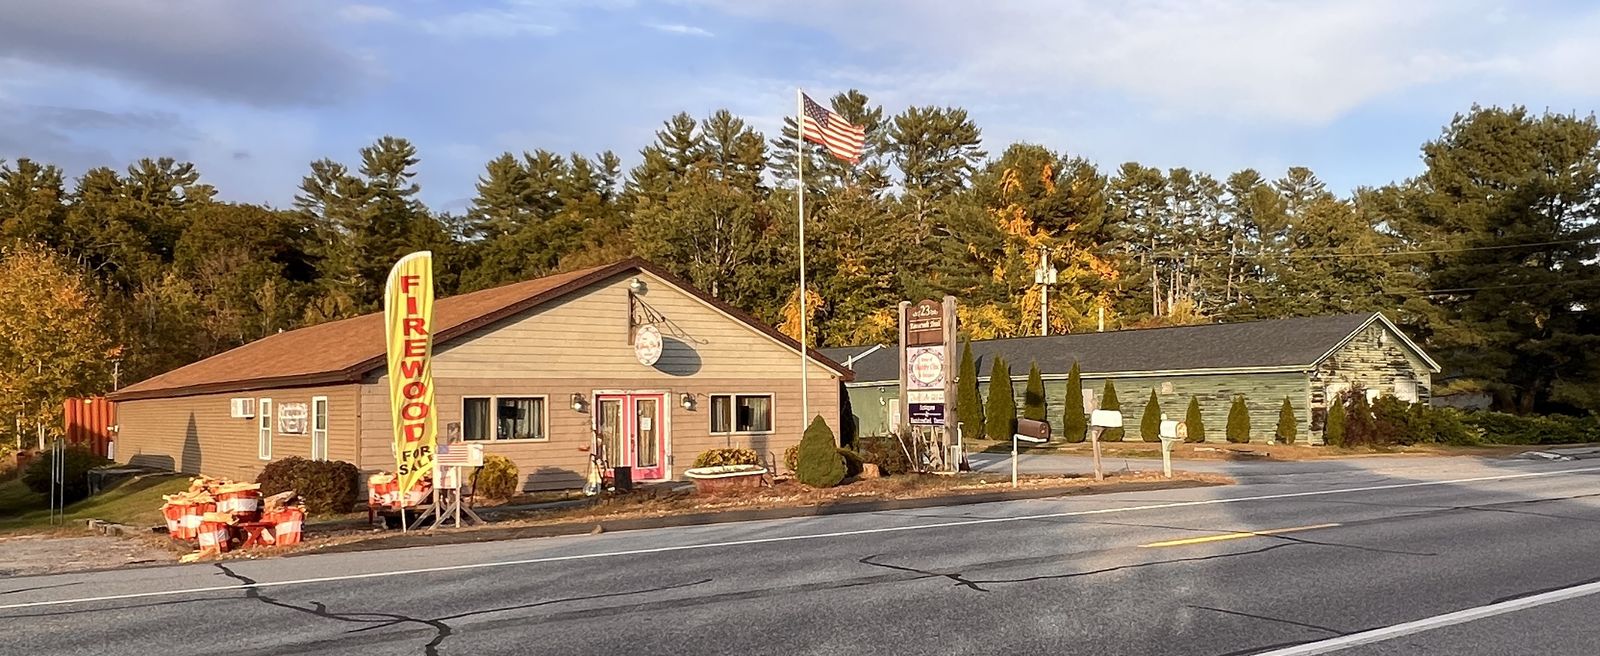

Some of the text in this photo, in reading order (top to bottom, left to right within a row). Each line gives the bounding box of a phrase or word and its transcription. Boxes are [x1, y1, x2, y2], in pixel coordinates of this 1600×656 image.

[920, 304, 931, 317] 23
[400, 275, 429, 443] FIREWOOD
[402, 445, 431, 462] FOR
